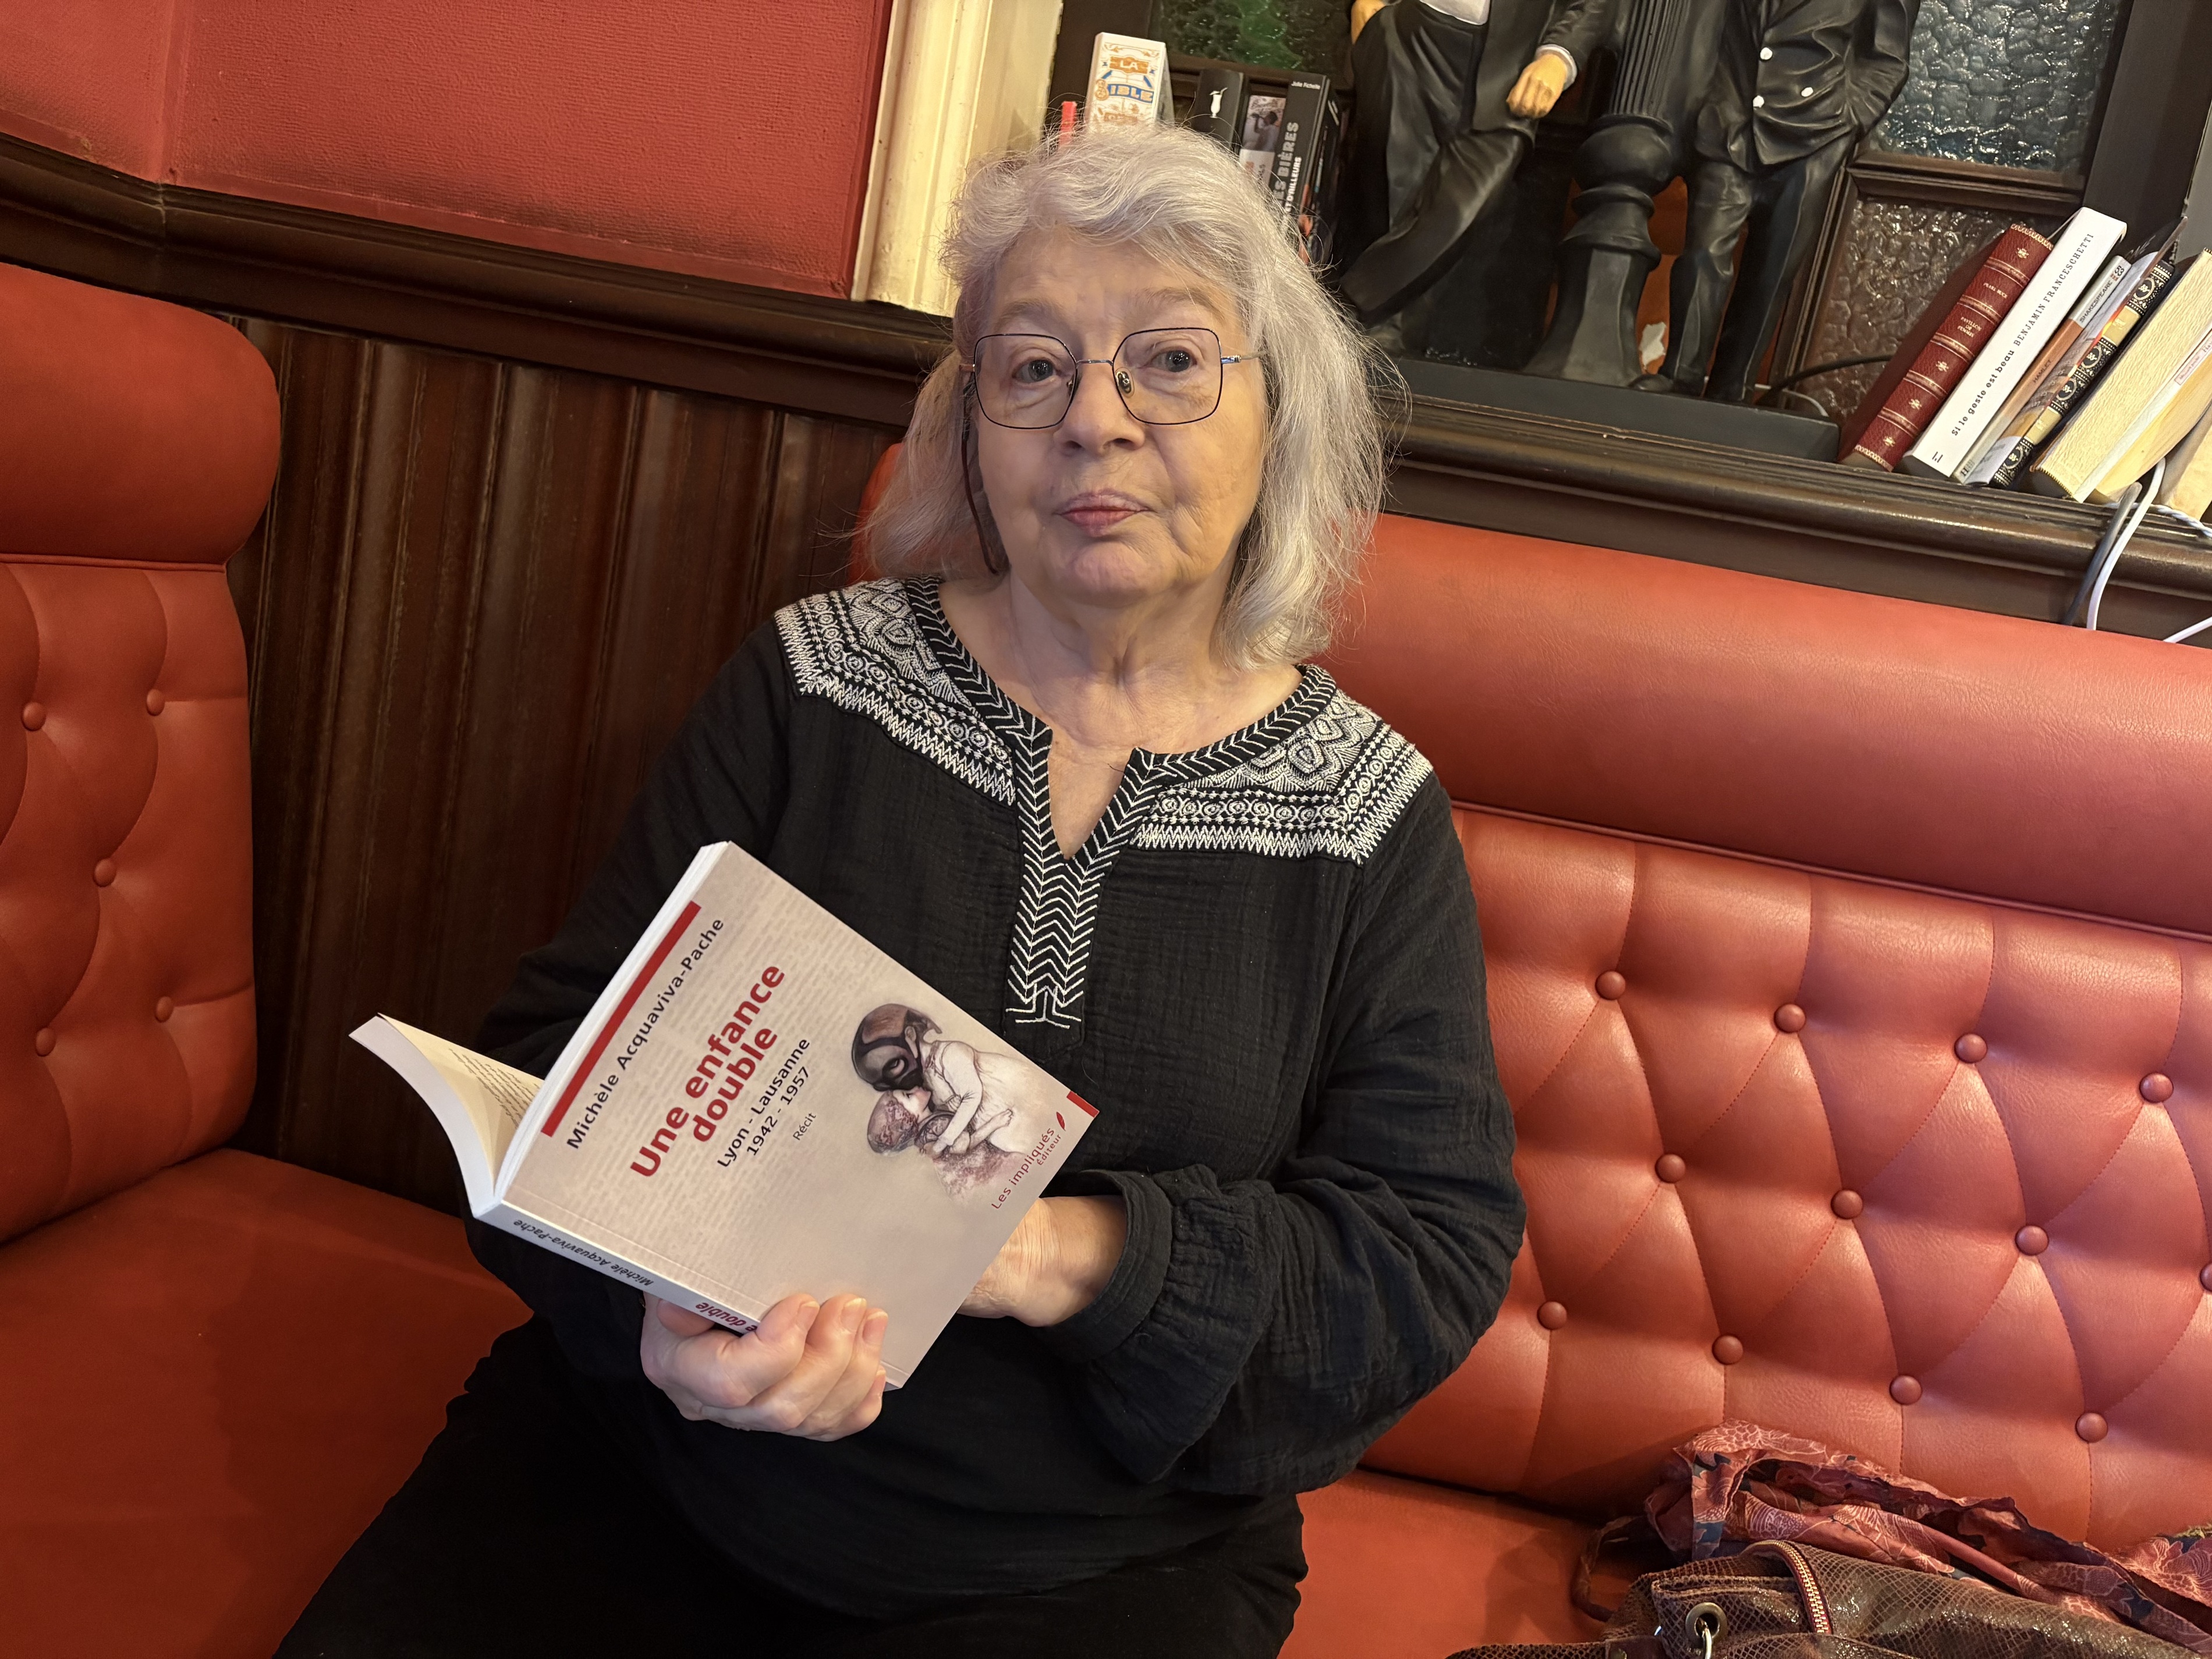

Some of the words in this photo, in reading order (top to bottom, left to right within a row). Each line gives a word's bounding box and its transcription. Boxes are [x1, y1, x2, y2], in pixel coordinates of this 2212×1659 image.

[1120, 60, 1138, 70] LA
[1094, 79, 1153, 102] BIBLE
[1277, 122, 1299, 177] BIÈRES
[2114, 265, 2125, 276] 53
[2079, 280, 2112, 323] SHAKESPEARE
[1951, 426, 1961, 436] Si
[1958, 416, 1968, 426] le
[1968, 390, 1986, 414] geste
[1986, 374, 1998, 388] est
[1995, 350, 2015, 373] beau
[2014, 304, 2046, 346] BENJAMIN
[2043, 233, 2094, 302] FRANCESCHETTI
[1961, 317, 1982, 332] PAVILLON
[2033, 360, 2052, 383] HAMLET
[566, 1073, 619, 1149] Michèle
[616, 919, 725, 1071] Acquaviva-Pache
[629, 1107, 690, 1177] Une
[685, 966, 785, 1099] enfance
[693, 1028, 778, 1143] double
[717, 1126, 750, 1168] Lyon
[750, 1038, 810, 1115] Lausanne
[747, 1115, 778, 1155] 1942
[781, 1066, 810, 1105] 1957
[792, 1112, 817, 1140] Récit
[991, 1187, 1012, 1209] Les
[1009, 1128, 1055, 1186] impliqués
[1037, 1134, 1062, 1166] Éditeur
[513, 1219, 610, 1267] Acquaviva-Pache
[611, 1264, 654, 1287] Michèle
[696, 1302, 747, 1326] double
